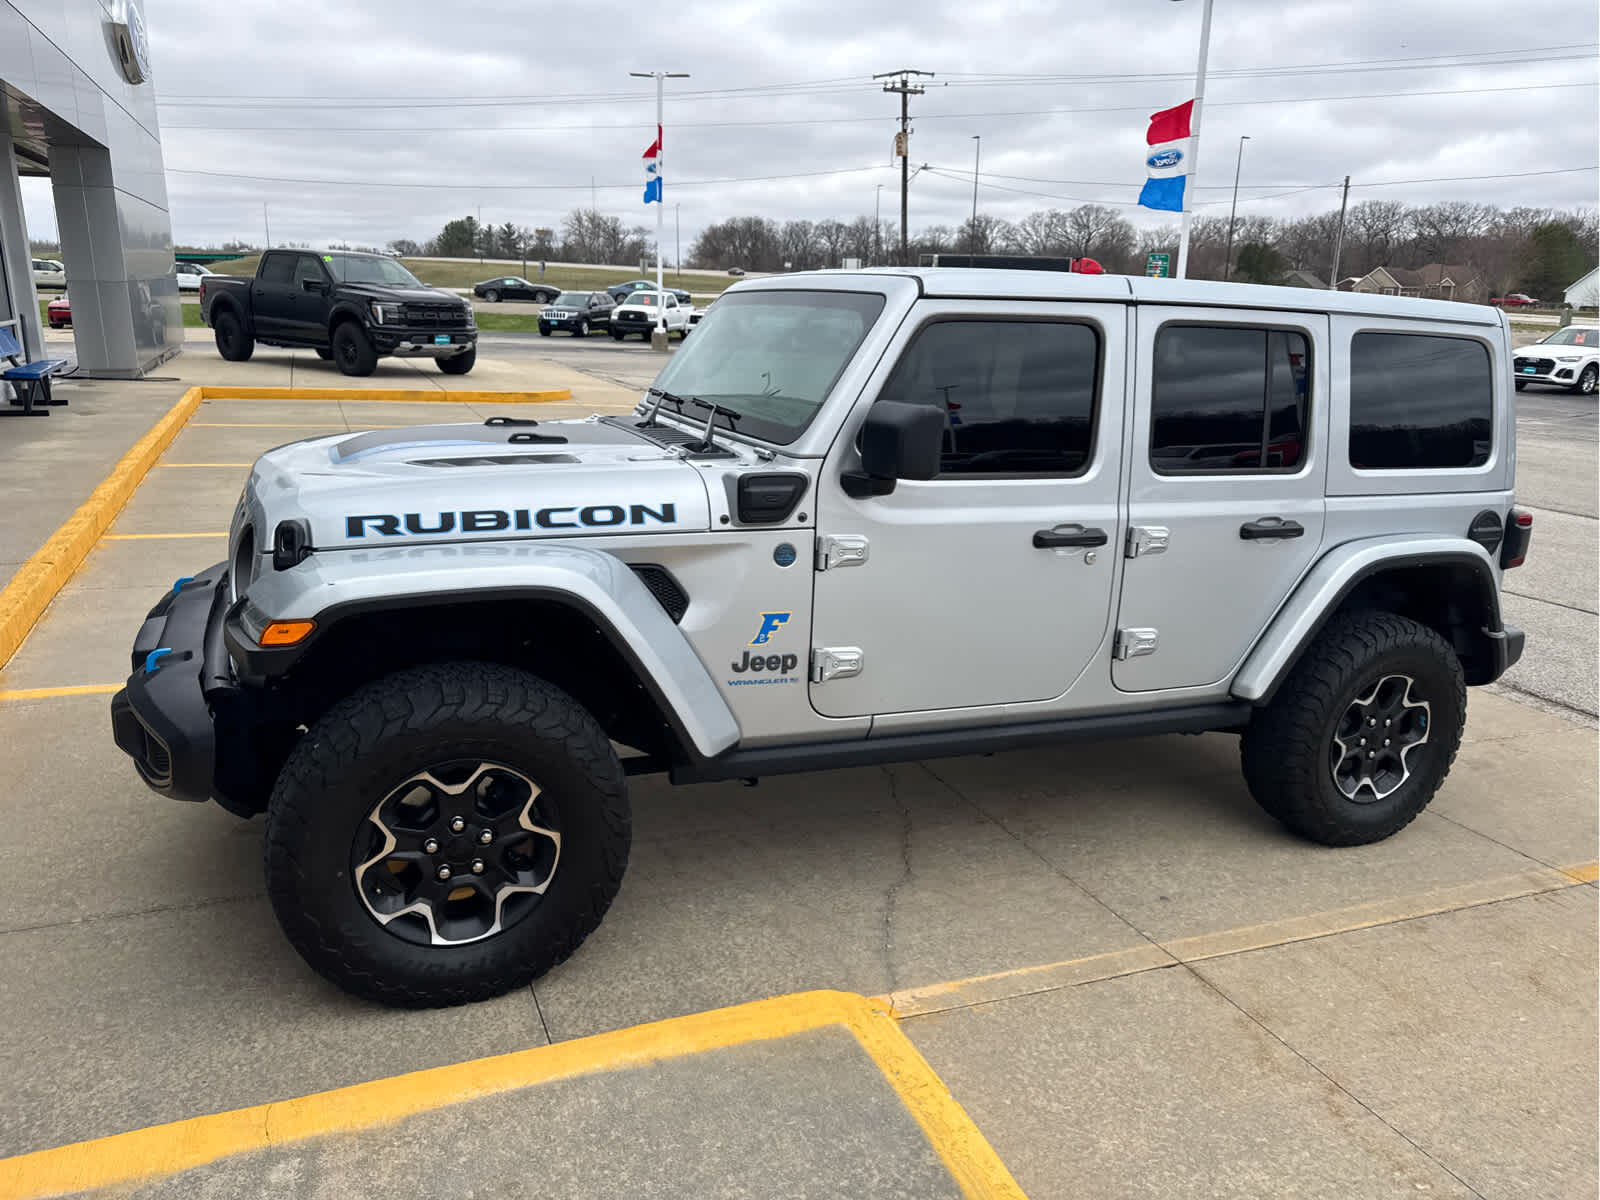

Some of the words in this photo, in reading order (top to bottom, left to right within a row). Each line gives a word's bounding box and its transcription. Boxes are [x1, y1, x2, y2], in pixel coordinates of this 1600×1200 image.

[345, 503, 677, 538] RUBICON
[746, 610, 793, 647] F
[731, 650, 798, 675] Jeep
